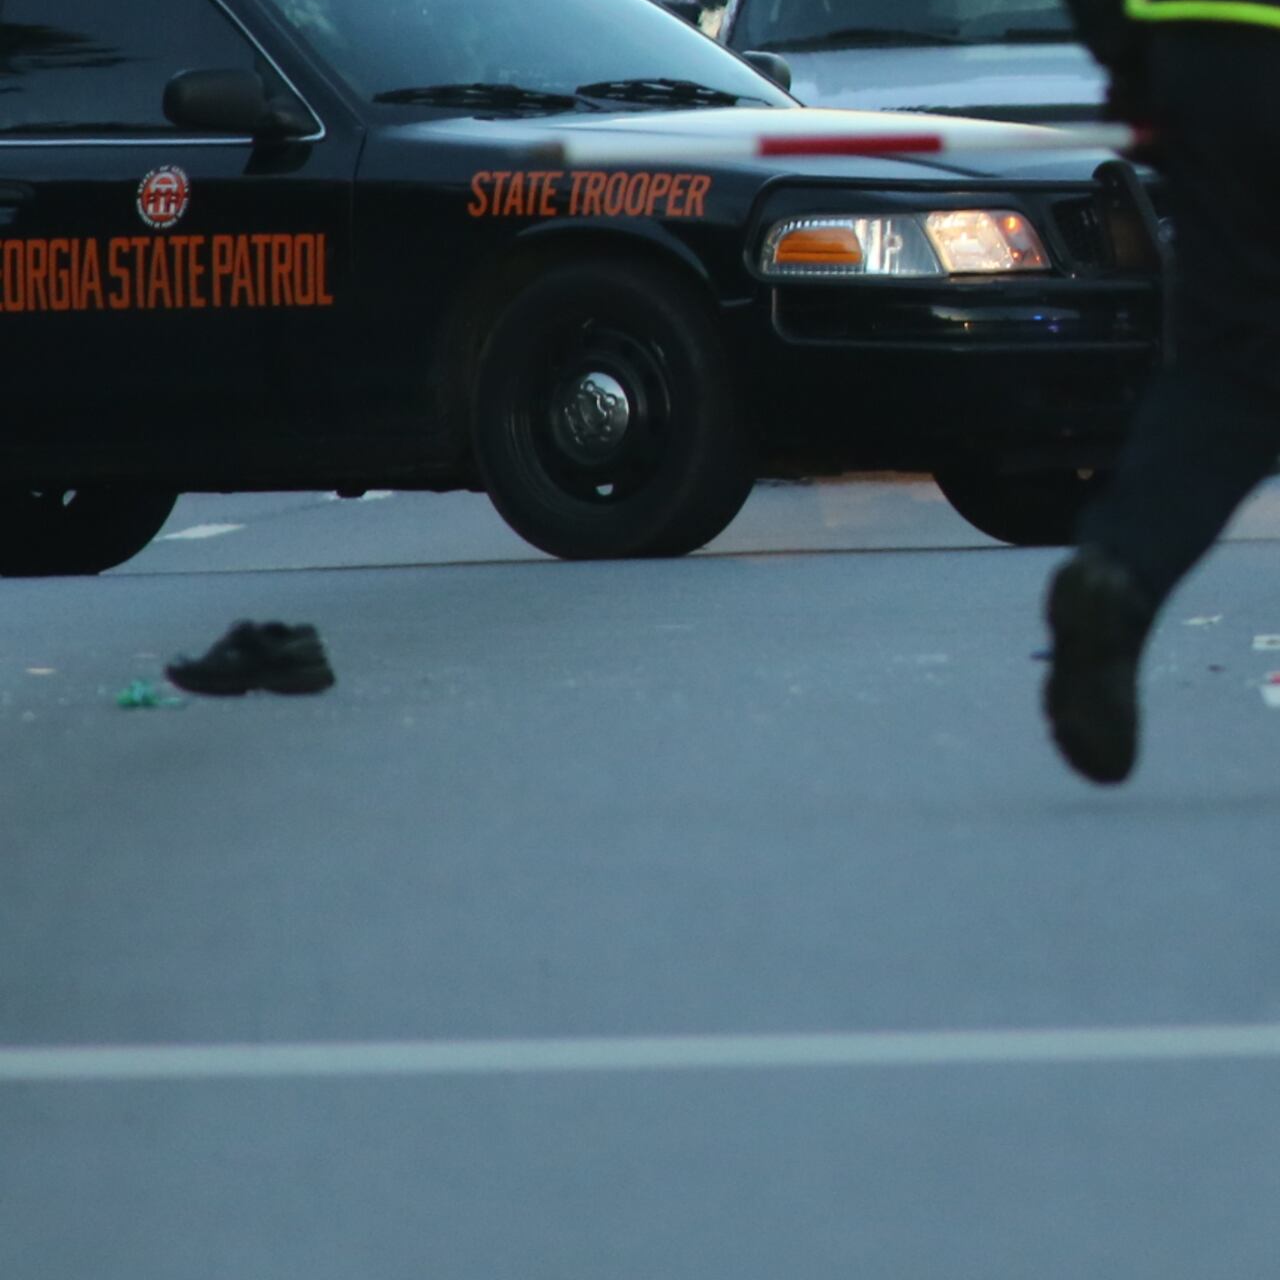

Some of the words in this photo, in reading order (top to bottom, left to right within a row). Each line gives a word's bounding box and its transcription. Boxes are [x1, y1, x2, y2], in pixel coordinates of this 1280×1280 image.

[467, 171, 564, 217] STATE
[569, 171, 712, 217] TROOPER
[0, 238, 104, 312] ORGIA
[108, 236, 207, 310] STATE
[211, 233, 333, 308] PATROL
